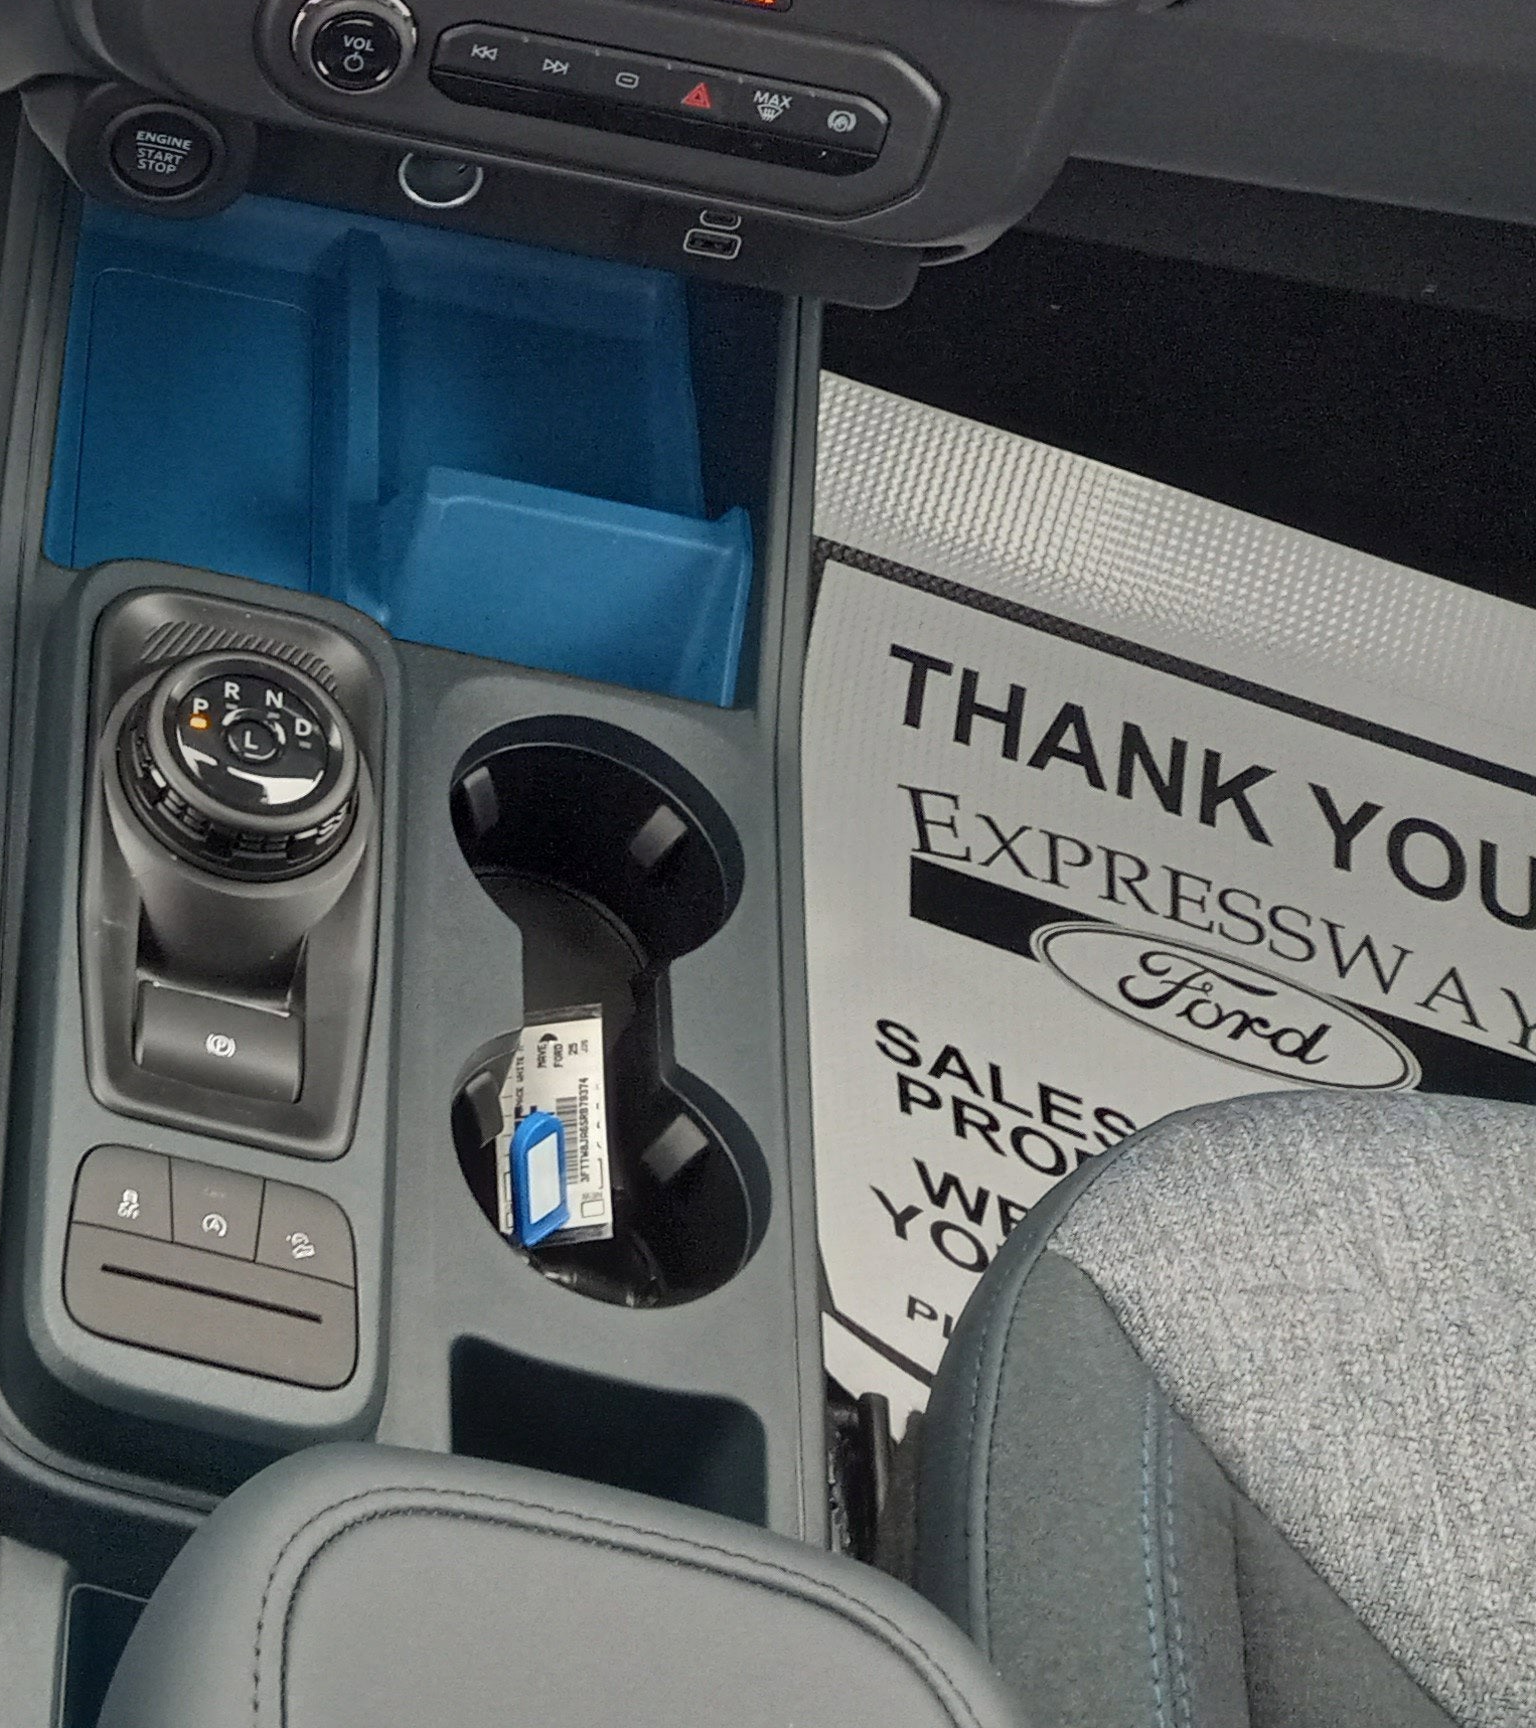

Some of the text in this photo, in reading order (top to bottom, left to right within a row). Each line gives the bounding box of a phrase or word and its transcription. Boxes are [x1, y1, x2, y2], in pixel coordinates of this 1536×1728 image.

[343, 34, 375, 52] VOL
[753, 90, 793, 109] MAX
[136, 129, 193, 151] ENGINE
[136, 148, 184, 166] START
[137, 158, 178, 175] STOP
[224, 681, 241, 701] R
[265, 688, 284, 709] N
[192, 696, 210, 715] P
[294, 717, 313, 737] D
[243, 730, 259, 750] L
[887, 642, 1536, 931] THANK YOU
[897, 783, 1536, 1057] EXPRESSWAY
[1117, 948, 1333, 1067] Ford
[553, 1043, 564, 1068] FORD
[874, 1018, 1137, 1150] SALES
[895, 1071, 1094, 1177] PRO
[868, 1184, 1004, 1273] YO
